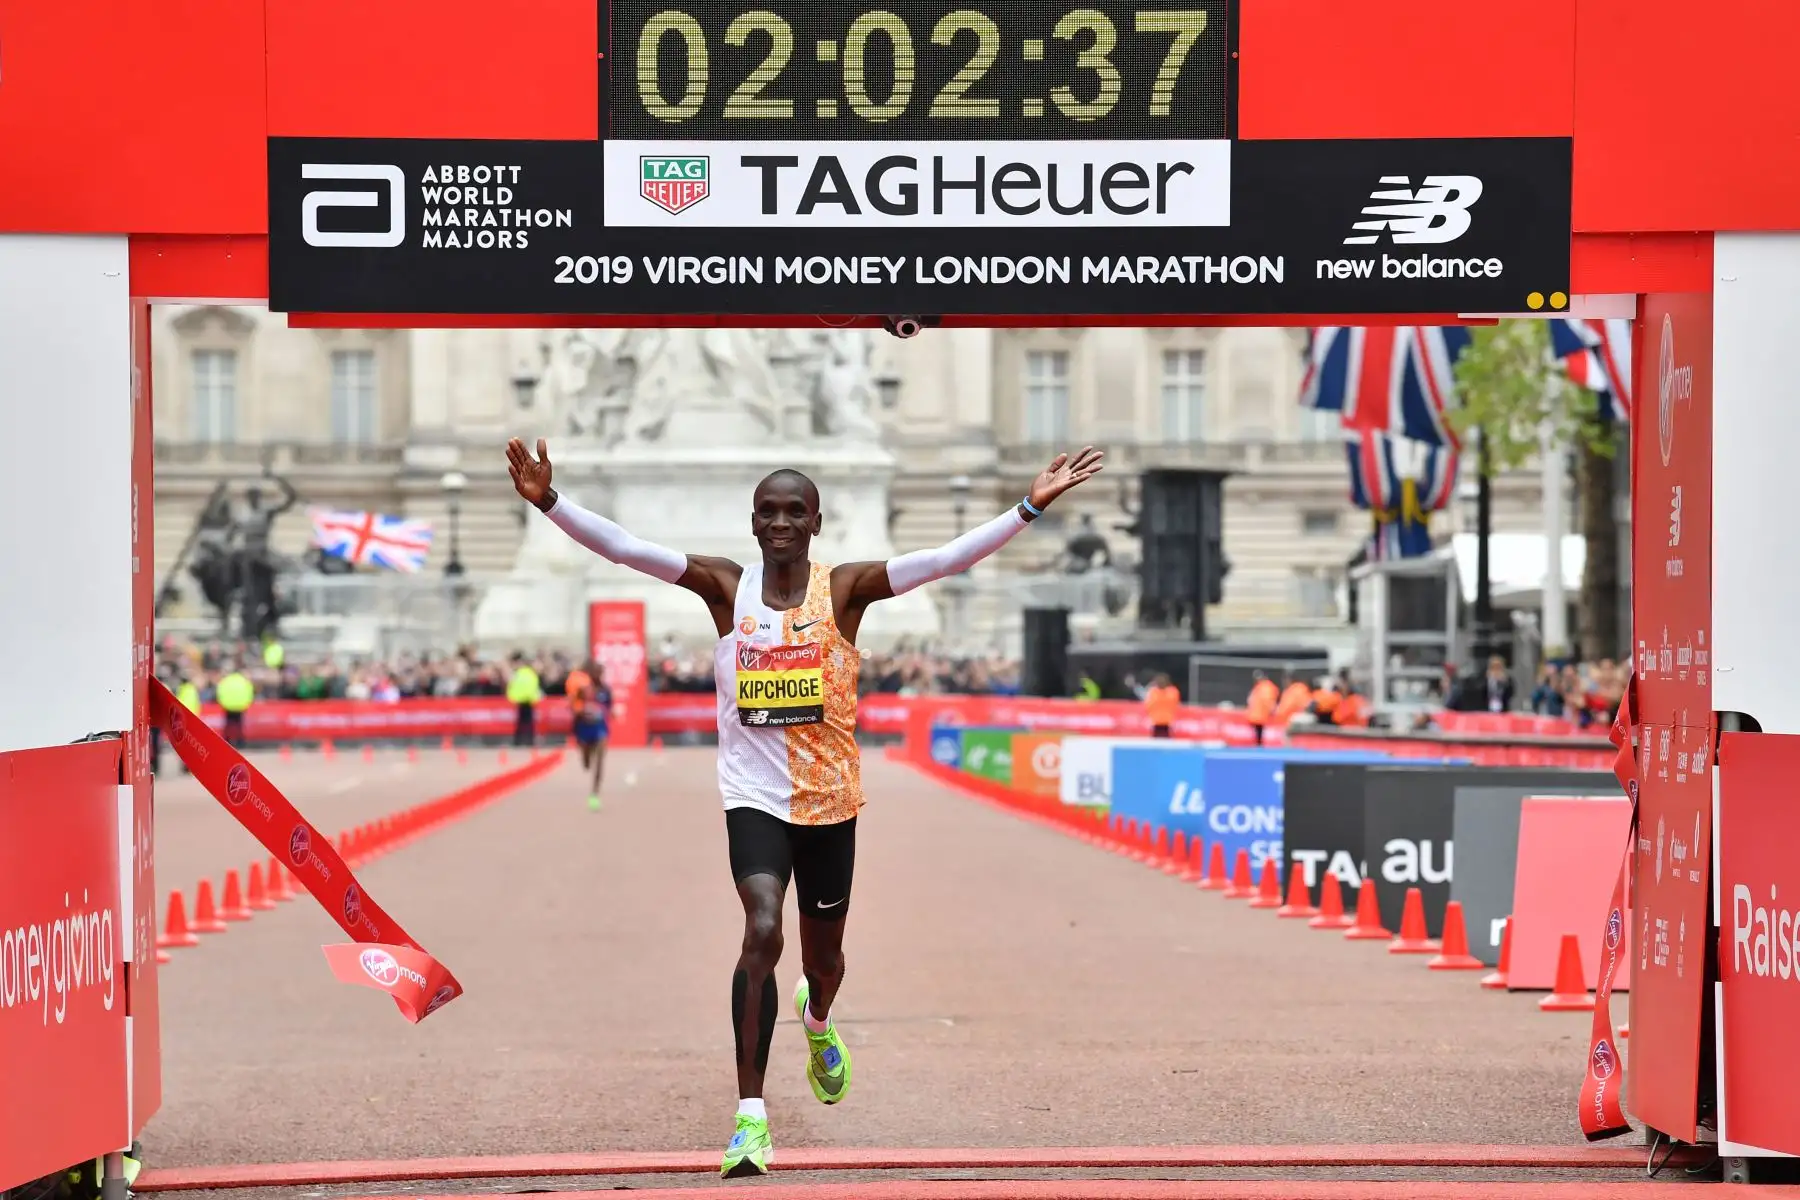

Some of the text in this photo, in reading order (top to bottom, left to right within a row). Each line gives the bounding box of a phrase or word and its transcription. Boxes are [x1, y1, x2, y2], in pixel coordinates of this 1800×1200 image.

[636, 10, 1208, 122] 02:02:37
[421, 164, 522, 184] ABBOTT
[646, 161, 702, 178] TAG
[421, 186, 513, 206] WORLD
[645, 182, 704, 209] HEUER
[422, 208, 572, 228] MARATHON
[422, 230, 529, 249] MAJORS
[553, 255, 1284, 285] 2019 VIRGIN MONEY LONDON MARATHON
[1316, 253, 1504, 279] new balance
[772, 648, 817, 661] money
[739, 678, 820, 699] KIPCHOGE
[184, 731, 210, 762] money
[249, 791, 275, 822] money
[309, 851, 332, 883] money
[1291, 850, 1367, 888] TA
[360, 911, 381, 942] money
[399, 966, 428, 991] mone
[1593, 1079, 1610, 1130] money
